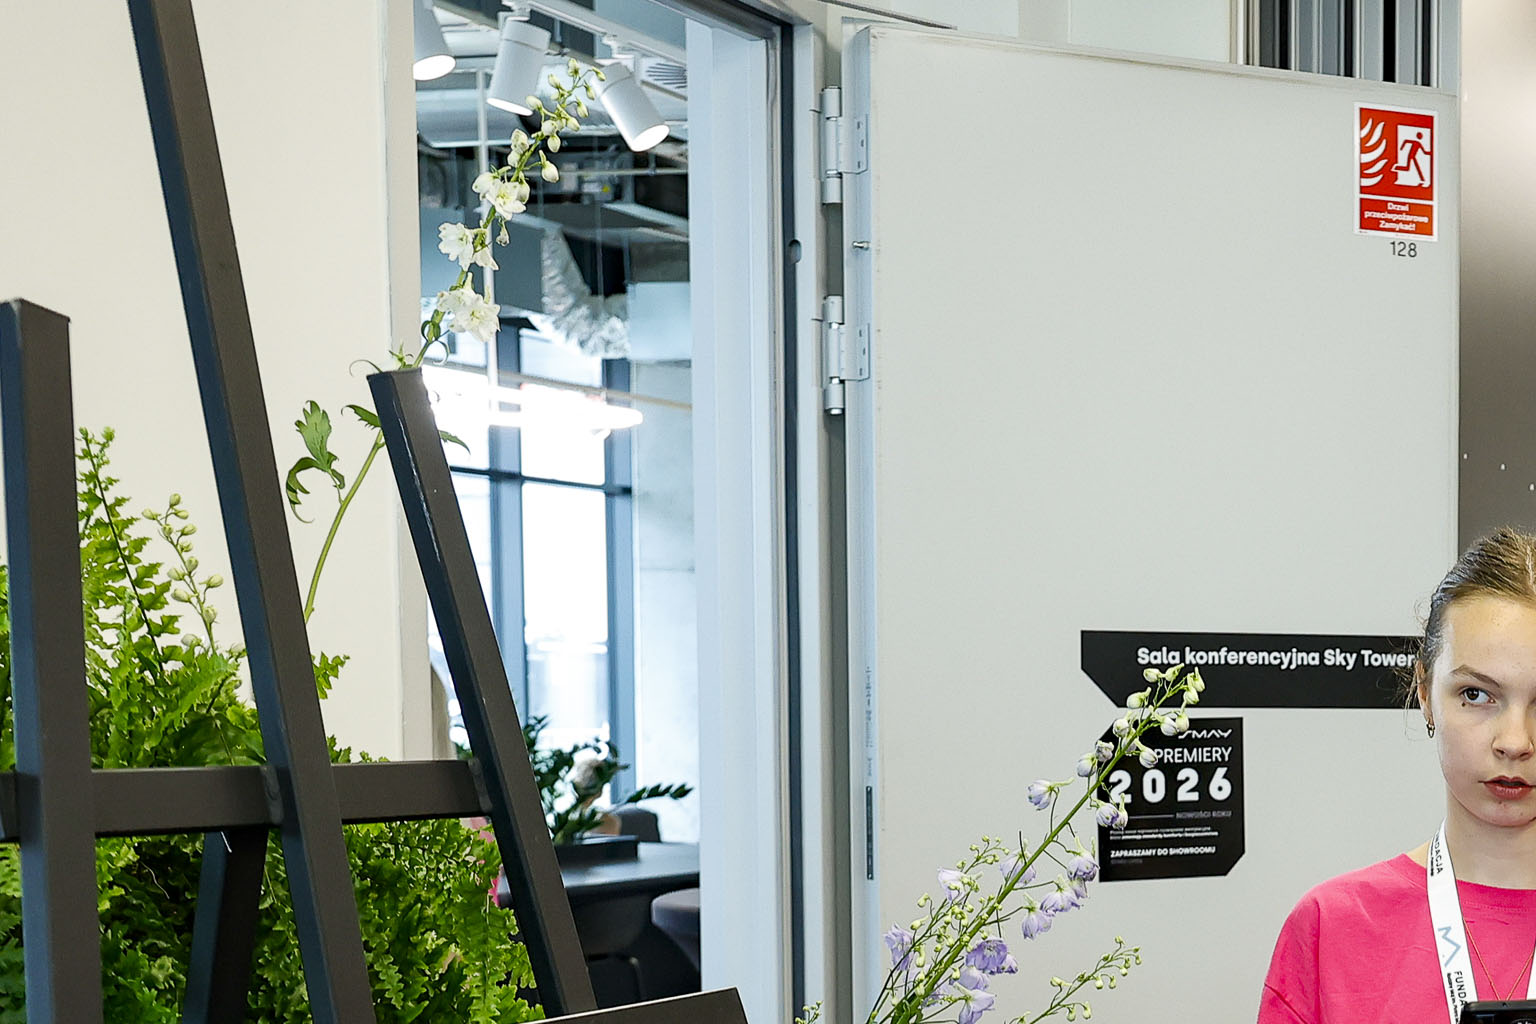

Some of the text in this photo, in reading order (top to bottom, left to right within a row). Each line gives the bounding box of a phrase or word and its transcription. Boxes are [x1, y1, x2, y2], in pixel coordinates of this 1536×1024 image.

[1390, 241, 1418, 258] 128
[1137, 647, 1416, 670] Sala konferencyjna Sky Tower
[1178, 729, 1232, 739] SMAY
[1153, 747, 1232, 763] PREMIERY
[1109, 767, 1232, 804] 2026
[1110, 848, 1157, 858] ZAPRASZAMY
[1157, 847, 1168, 856] DO
[1454, 970, 1468, 1007] FUNDA
